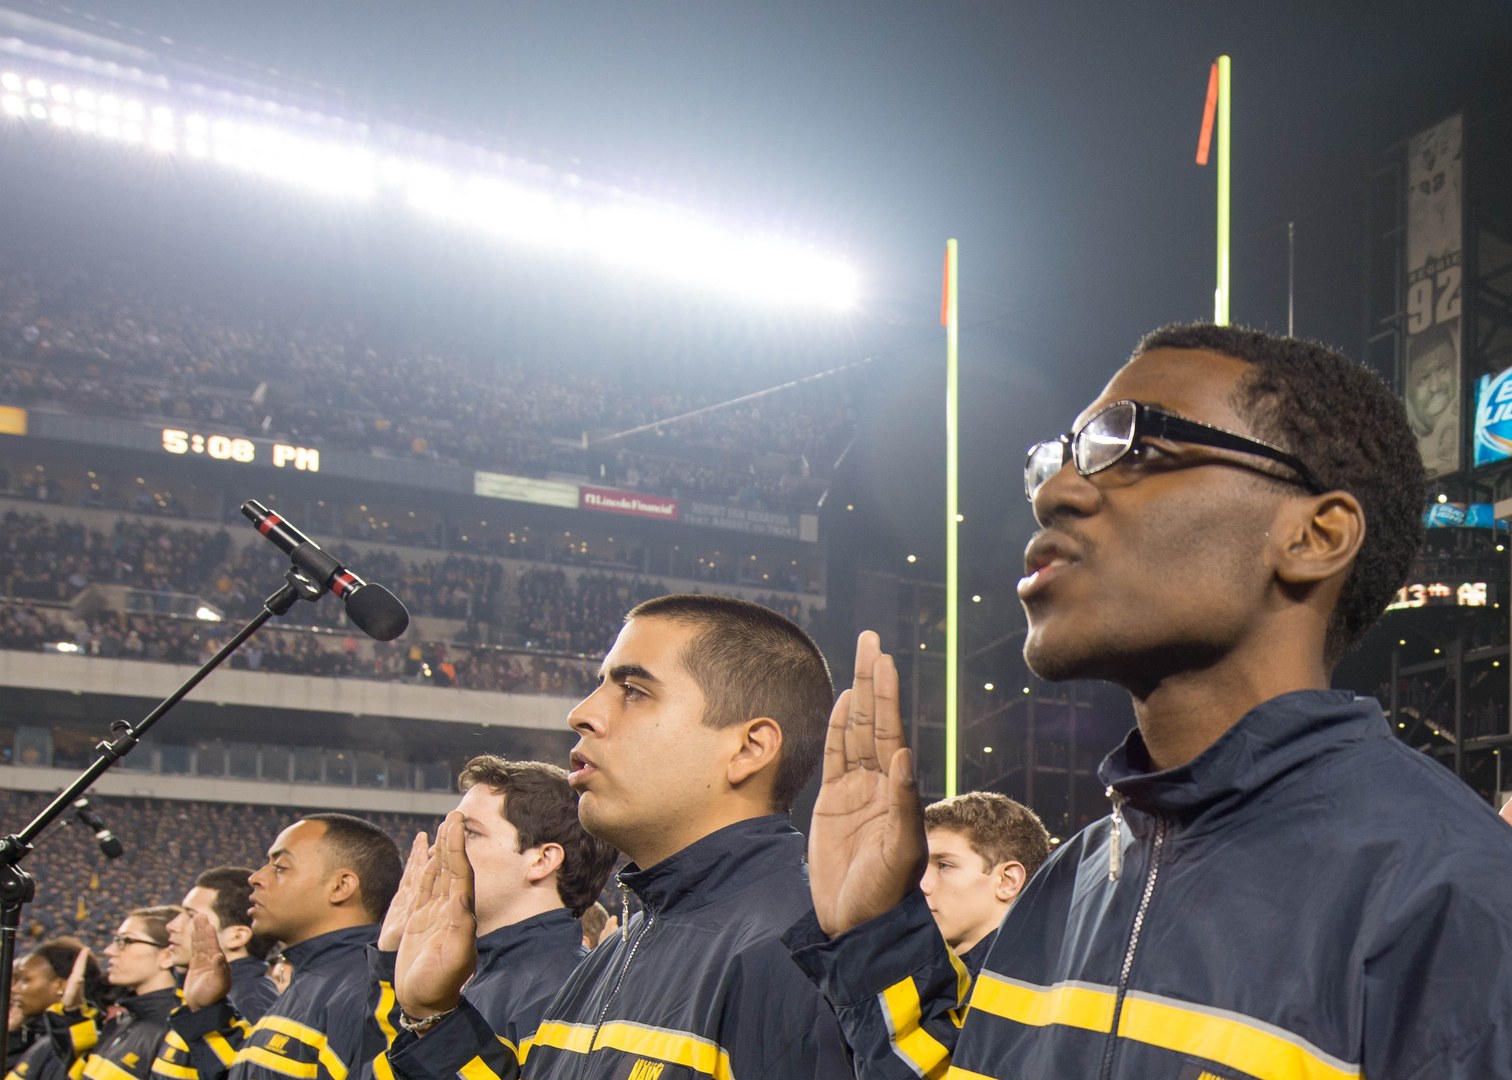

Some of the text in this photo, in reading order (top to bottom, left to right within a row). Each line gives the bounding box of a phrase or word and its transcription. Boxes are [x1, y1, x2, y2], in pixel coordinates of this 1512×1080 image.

[1407, 265, 1463, 334] 92
[162, 428, 320, 473] 5:08 PM
[597, 494, 674, 515] Lincoln Financial
[1384, 583, 1451, 611] 13th
